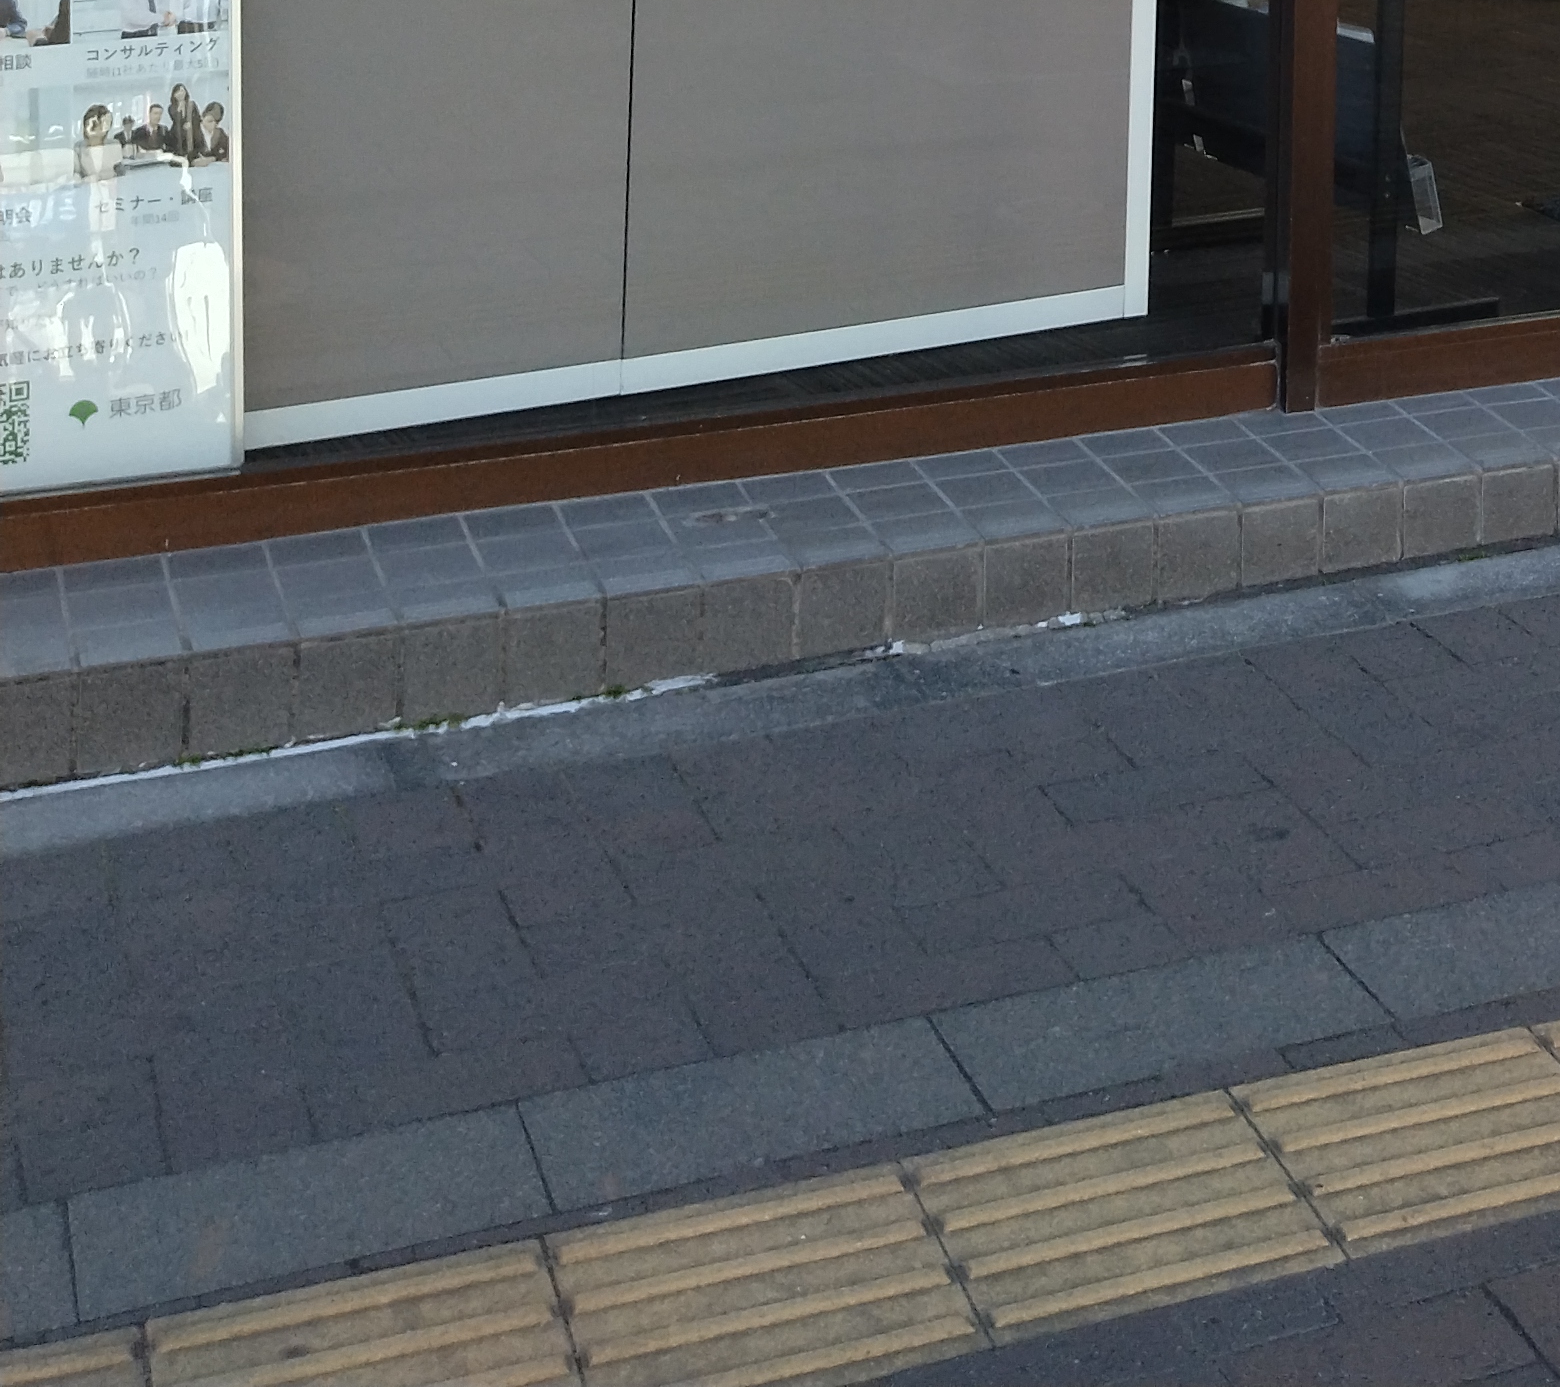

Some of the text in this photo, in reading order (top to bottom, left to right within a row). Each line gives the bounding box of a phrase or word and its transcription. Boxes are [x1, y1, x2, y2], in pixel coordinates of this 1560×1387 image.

[86, 37, 220, 63] コンサルティング
[109, 388, 183, 420] 東京都
